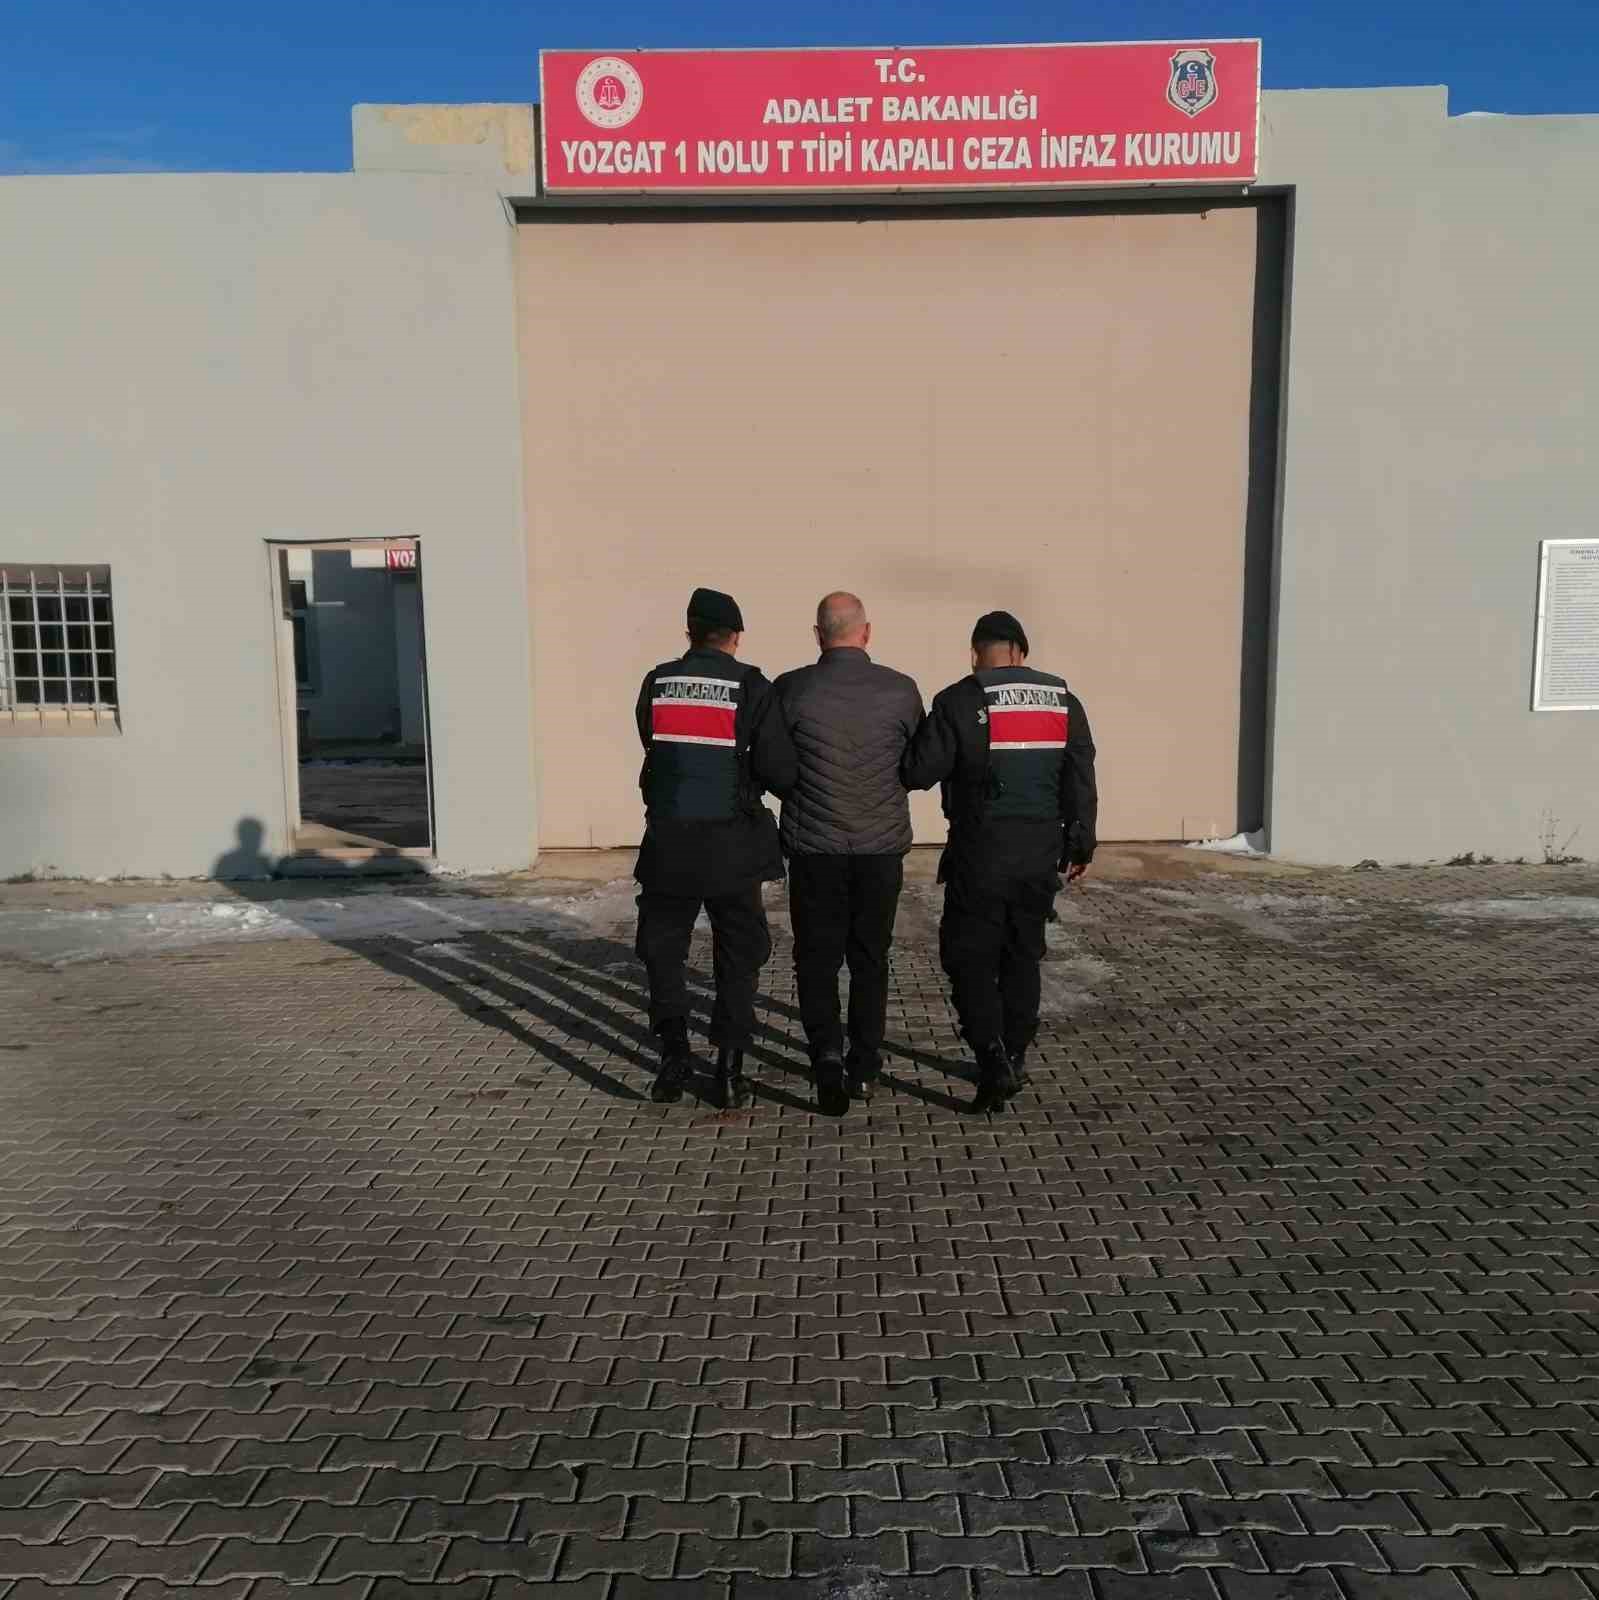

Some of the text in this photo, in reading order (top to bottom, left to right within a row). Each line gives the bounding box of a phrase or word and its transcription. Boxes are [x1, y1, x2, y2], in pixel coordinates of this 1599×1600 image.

[875, 58, 926, 84] T.C.
[763, 89, 1038, 124] ADALET BAKANLIĞI
[561, 128, 1241, 174] YOZGAT 1 NOLU T TİPİ KAPALI CEZA İNFAZ KURUMU
[661, 682, 730, 703] JANDARMA
[995, 688, 1060, 707] JANDARMA
